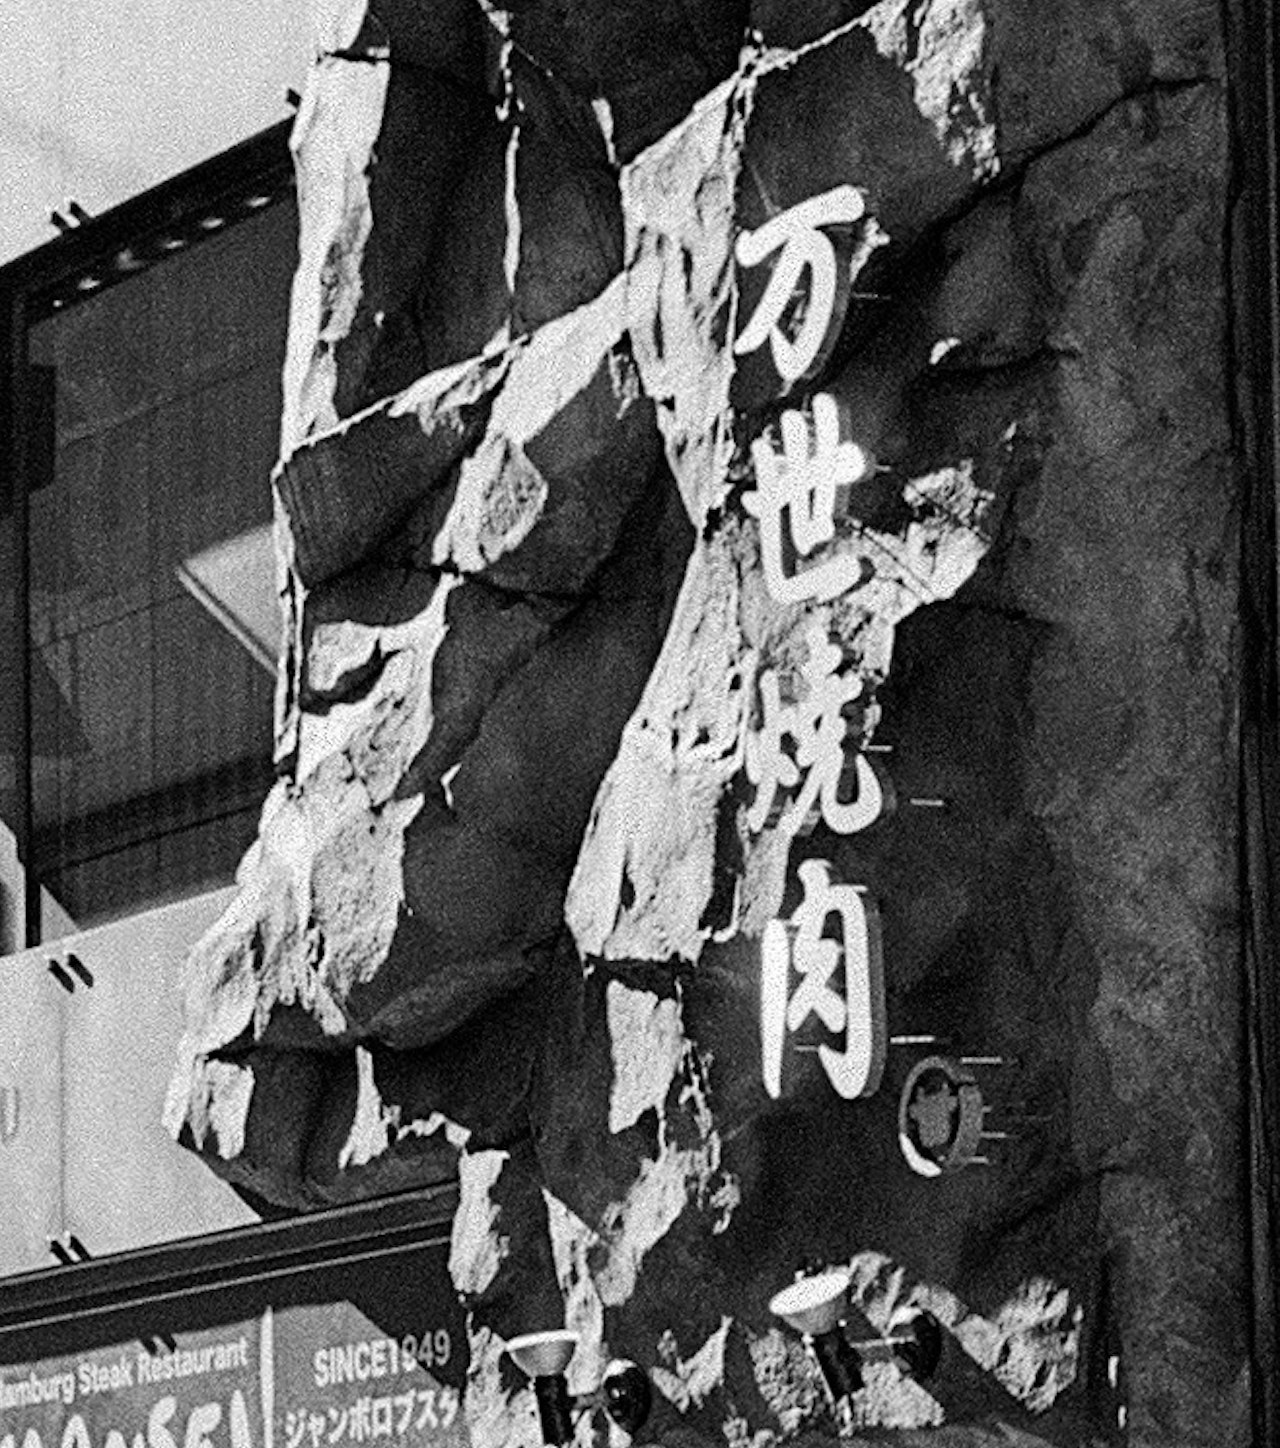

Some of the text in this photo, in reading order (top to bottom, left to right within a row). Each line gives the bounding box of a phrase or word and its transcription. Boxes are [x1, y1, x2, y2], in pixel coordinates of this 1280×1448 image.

[735, 185, 886, 1098] 万世焼肉
[77, 1355, 134, 1396] Steak
[137, 1336, 249, 1384] Restaurant
